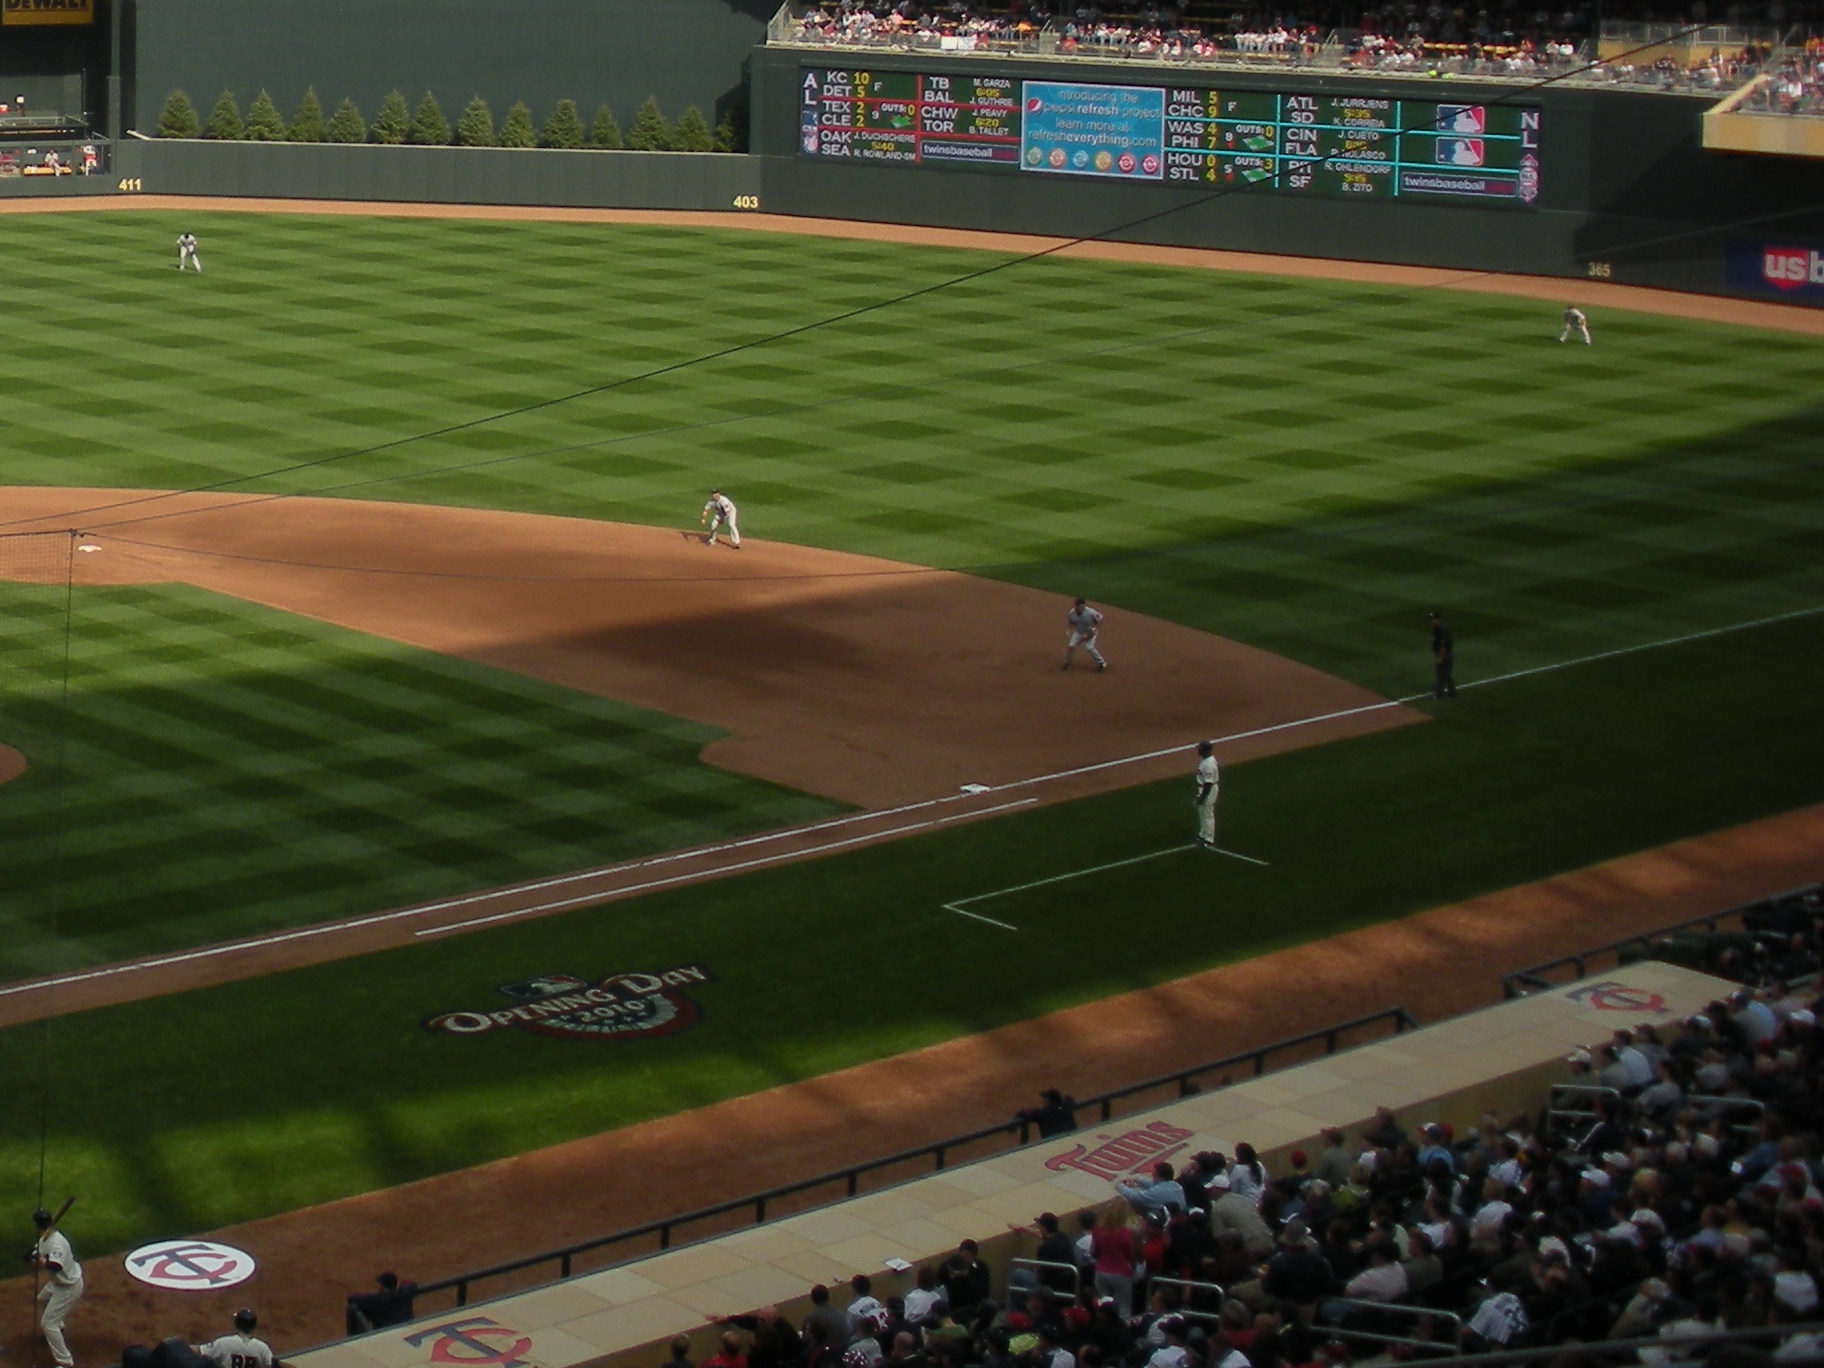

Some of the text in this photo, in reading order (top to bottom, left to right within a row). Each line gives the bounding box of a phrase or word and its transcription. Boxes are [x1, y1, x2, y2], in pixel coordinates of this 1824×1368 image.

[827, 72, 848, 83] KC
[930, 77, 949, 88] TB
[823, 85, 851, 96] DET
[925, 91, 954, 102] BAL
[1173, 90, 1200, 104] MIL
[824, 101, 850, 112] TEX
[921, 106, 958, 118] CHW
[1168, 105, 1203, 117] CHC
[822, 114, 850, 126] CLE
[924, 120, 953, 132] TOR
[1168, 121, 1203, 133] WAS
[1287, 128, 1316, 141] CIN
[1286, 143, 1317, 155] FLA
[1170, 168, 1199, 180] STL
[119, 179, 141, 190] 411
[733, 196, 758, 208] 403
[1589, 263, 1610, 276] 365
